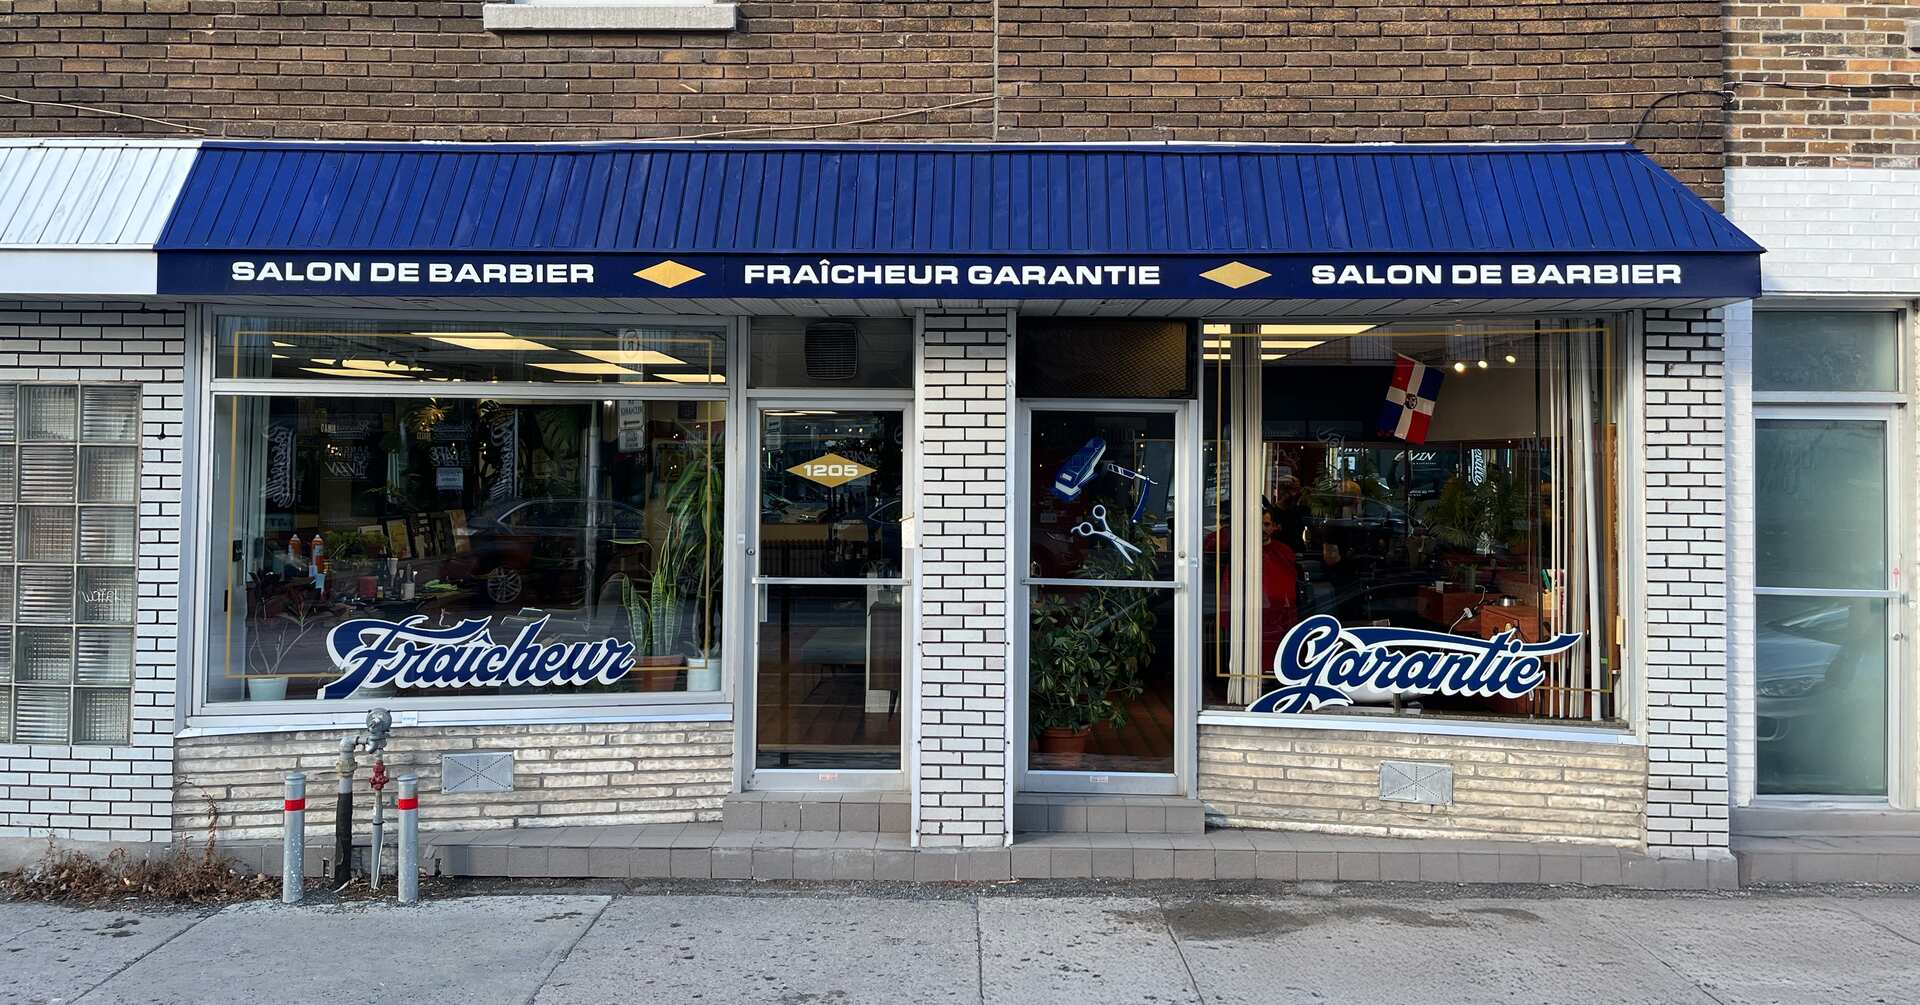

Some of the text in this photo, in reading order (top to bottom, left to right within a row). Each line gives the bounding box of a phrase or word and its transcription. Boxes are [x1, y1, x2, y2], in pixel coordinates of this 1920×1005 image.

[231, 261, 595, 284] SALON DE BARBIER
[744, 258, 1161, 285] FRAÎCHEUR GARANTIE
[1311, 264, 1683, 285] SALON DE BARBIER
[803, 463, 859, 477] 1205
[317, 613, 636, 699] Fraîcheur
[1246, 615, 1583, 712] Garantie
